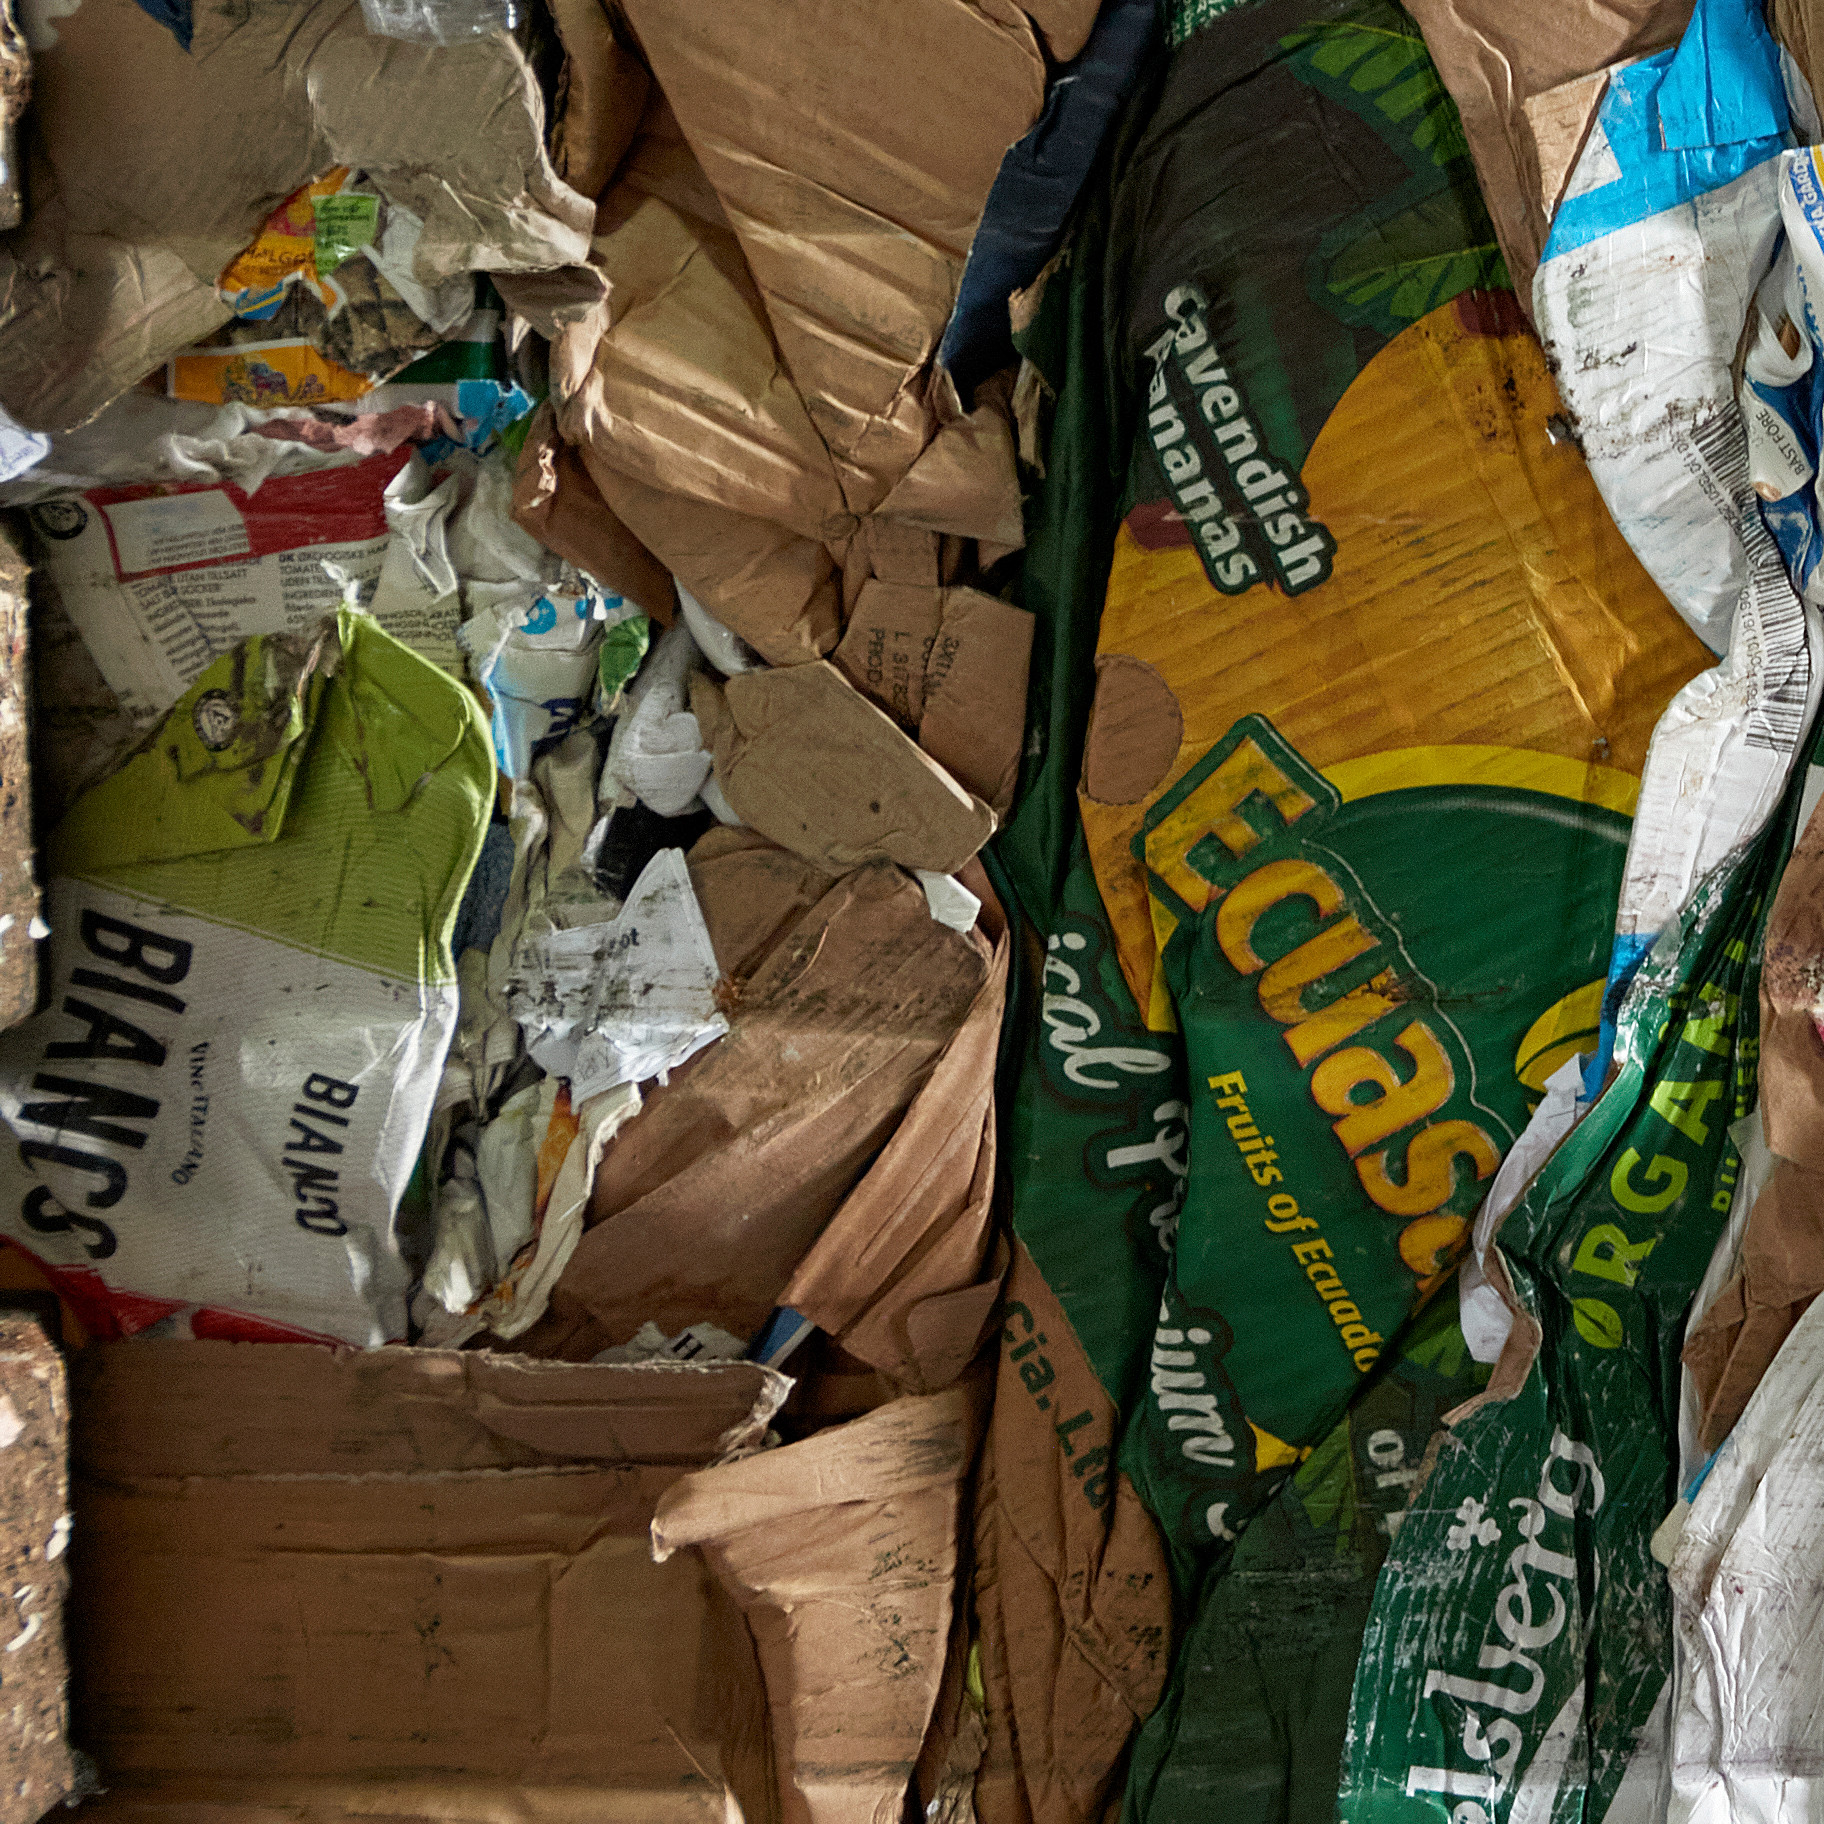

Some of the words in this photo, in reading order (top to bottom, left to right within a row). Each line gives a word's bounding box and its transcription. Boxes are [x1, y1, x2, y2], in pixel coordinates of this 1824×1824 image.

[1164, 284, 1334, 590] Cavendish
[169, 1092, 212, 1188] ITALIANO
[281, 1072, 361, 1237] BIANCO
[1207, 1068, 1285, 1188] Fruits
[1264, 1192, 1319, 1233] of
